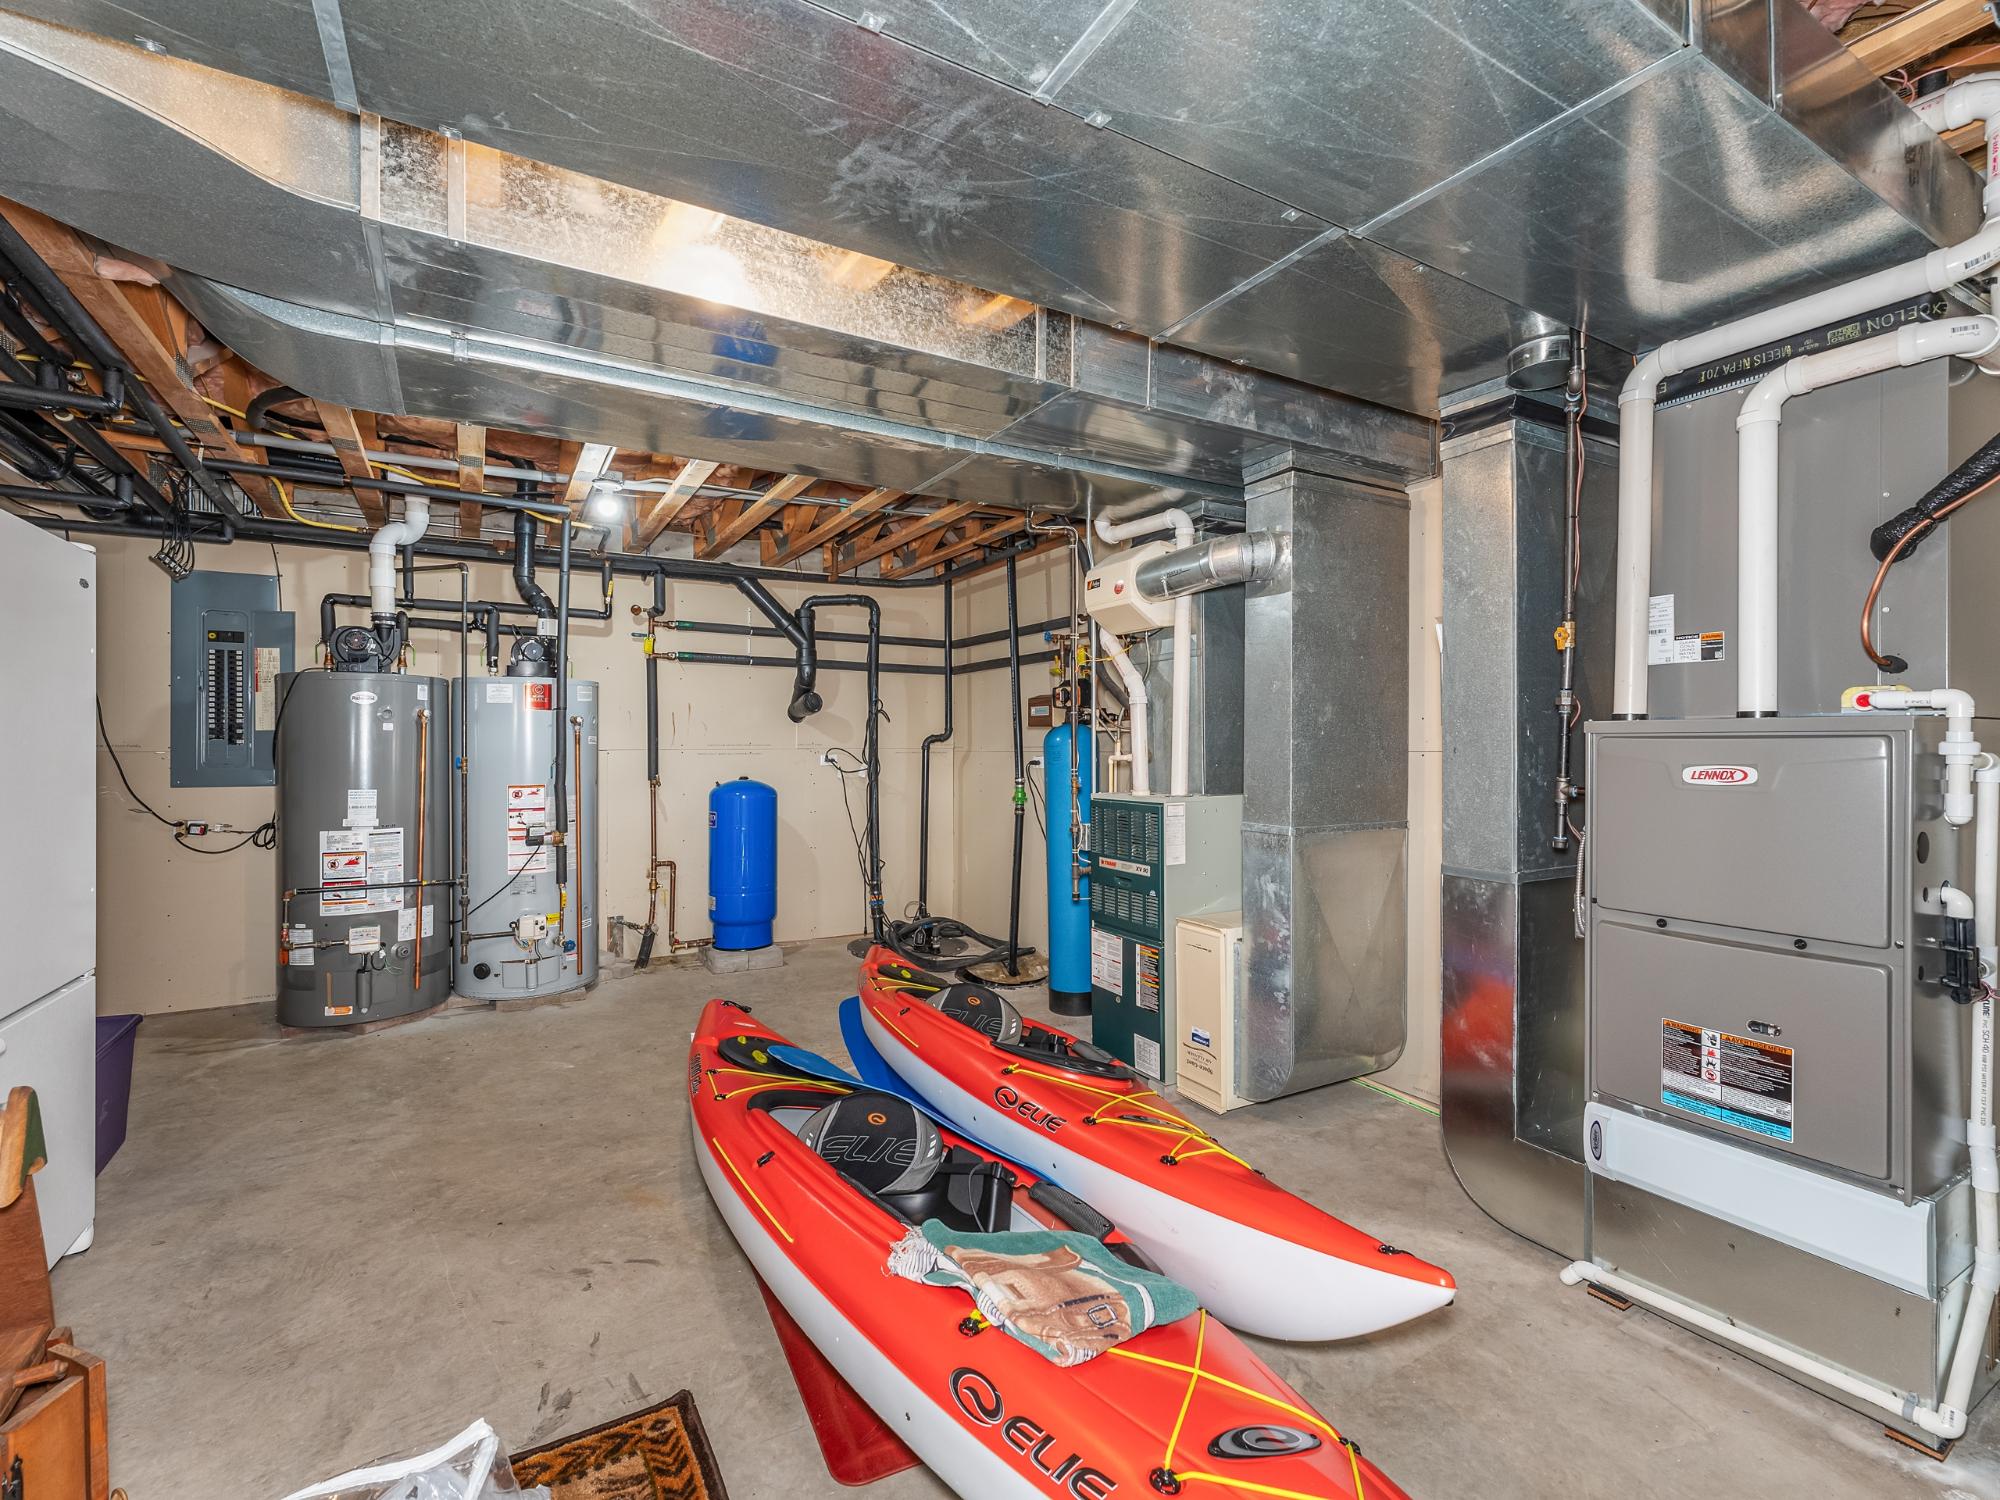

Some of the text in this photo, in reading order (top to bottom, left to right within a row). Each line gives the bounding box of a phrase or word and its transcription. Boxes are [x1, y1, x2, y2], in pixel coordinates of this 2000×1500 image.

[1691, 770, 1737, 780] LENNOX
[1016, 1101, 1068, 1134] ELIE
[820, 1135, 918, 1166] ELIE
[1001, 1415, 1119, 1500] ELIE
